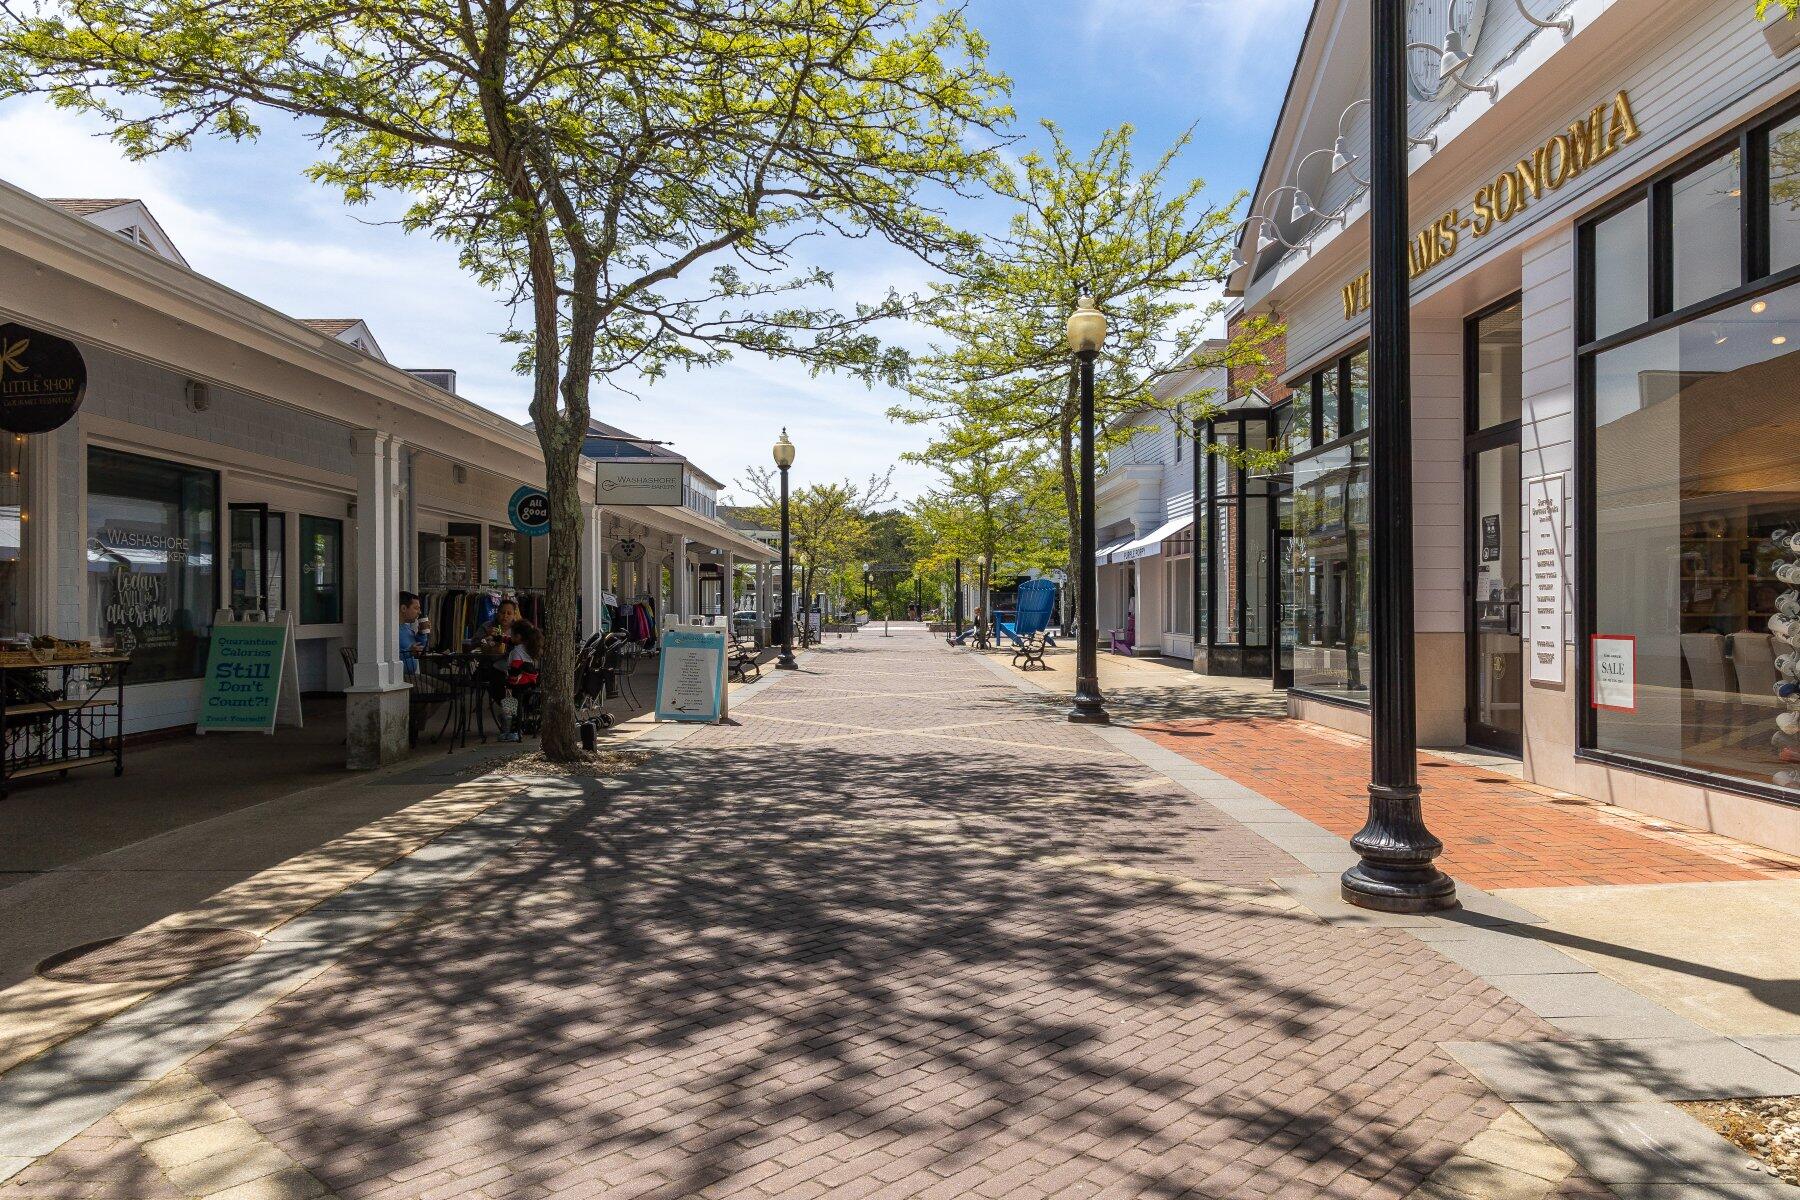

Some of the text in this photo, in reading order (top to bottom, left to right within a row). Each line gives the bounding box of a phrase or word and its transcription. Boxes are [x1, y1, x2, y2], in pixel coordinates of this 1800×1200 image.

[1341, 89, 1642, 321] WIAMS-SONOMA
[2, 377, 75, 393] LITTLE SHOP
[617, 475, 677, 484] WASHASHORE
[529, 499, 543, 507] All
[521, 507, 547, 520] good
[107, 529, 190, 550] WASHASHORE
[106, 599, 173, 628] awesome!
[218, 637, 278, 647] Quarantine
[220, 648, 272, 657] Calories
[215, 662, 270, 679] Still
[1601, 661, 1625, 676] SALE
[218, 680, 264, 692] Don't
[208, 696, 269, 707] Count?!
